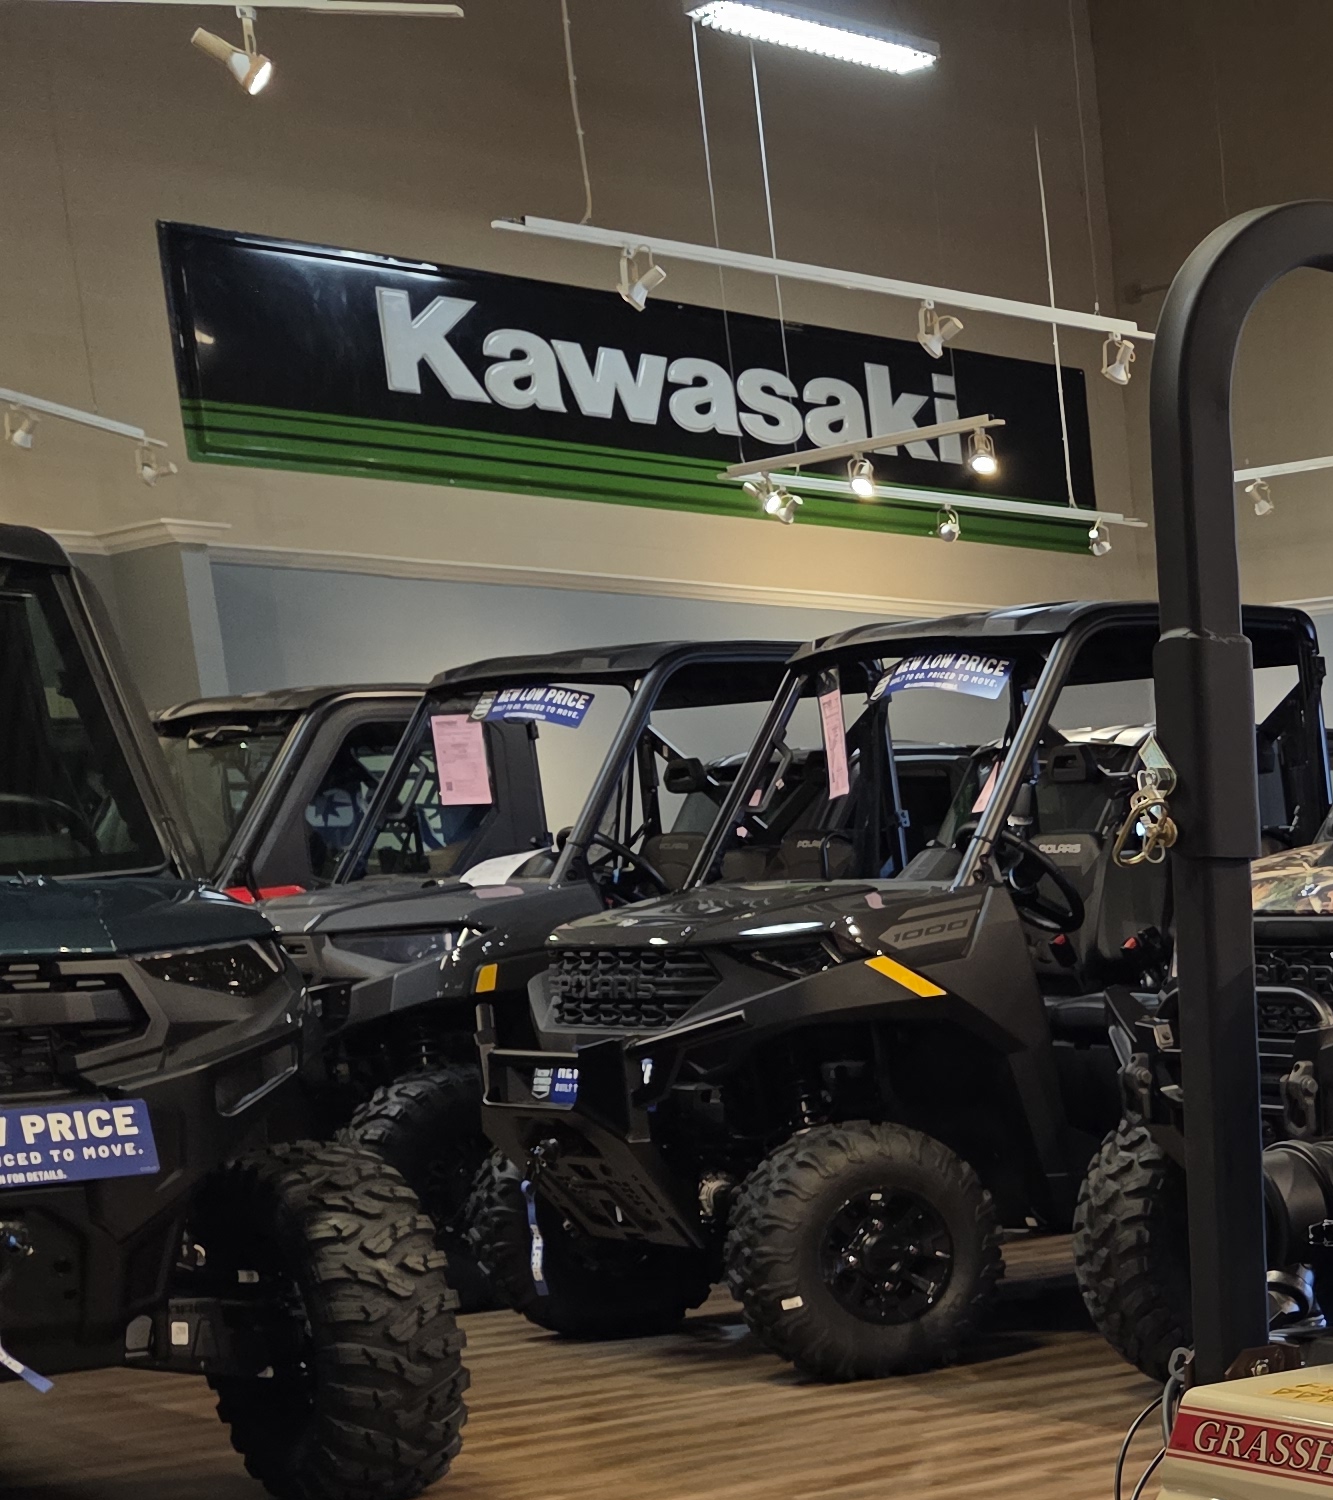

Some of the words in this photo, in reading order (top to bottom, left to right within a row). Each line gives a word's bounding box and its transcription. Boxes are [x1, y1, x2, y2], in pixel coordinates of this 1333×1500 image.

[375, 286, 963, 464] Kawasaki
[922, 653, 956, 670] LOW
[954, 654, 1010, 677] PRICE
[927, 671, 956, 680] PRICED
[957, 673, 969, 682] TO
[497, 688, 524, 703] NEW
[519, 688, 547, 701] LOW
[545, 688, 590, 710] PRICE
[522, 703, 545, 713] PRICED
[545, 705, 555, 714] TO
[556, 708, 580, 720] MOVE.
[797, 839, 831, 849] POLARS
[1038, 843, 1082, 854] POLARIS
[893, 918, 968, 943] 1000
[548, 970, 658, 998] POLARIS
[20, 1106, 139, 1144] PRICE
[0, 1151, 42, 1167] CED
[49, 1149, 75, 1163] TO
[83, 1142, 144, 1160] MOVE.
[7, 1172, 26, 1184] FOR
[26, 1168, 68, 1183] DETAILS.
